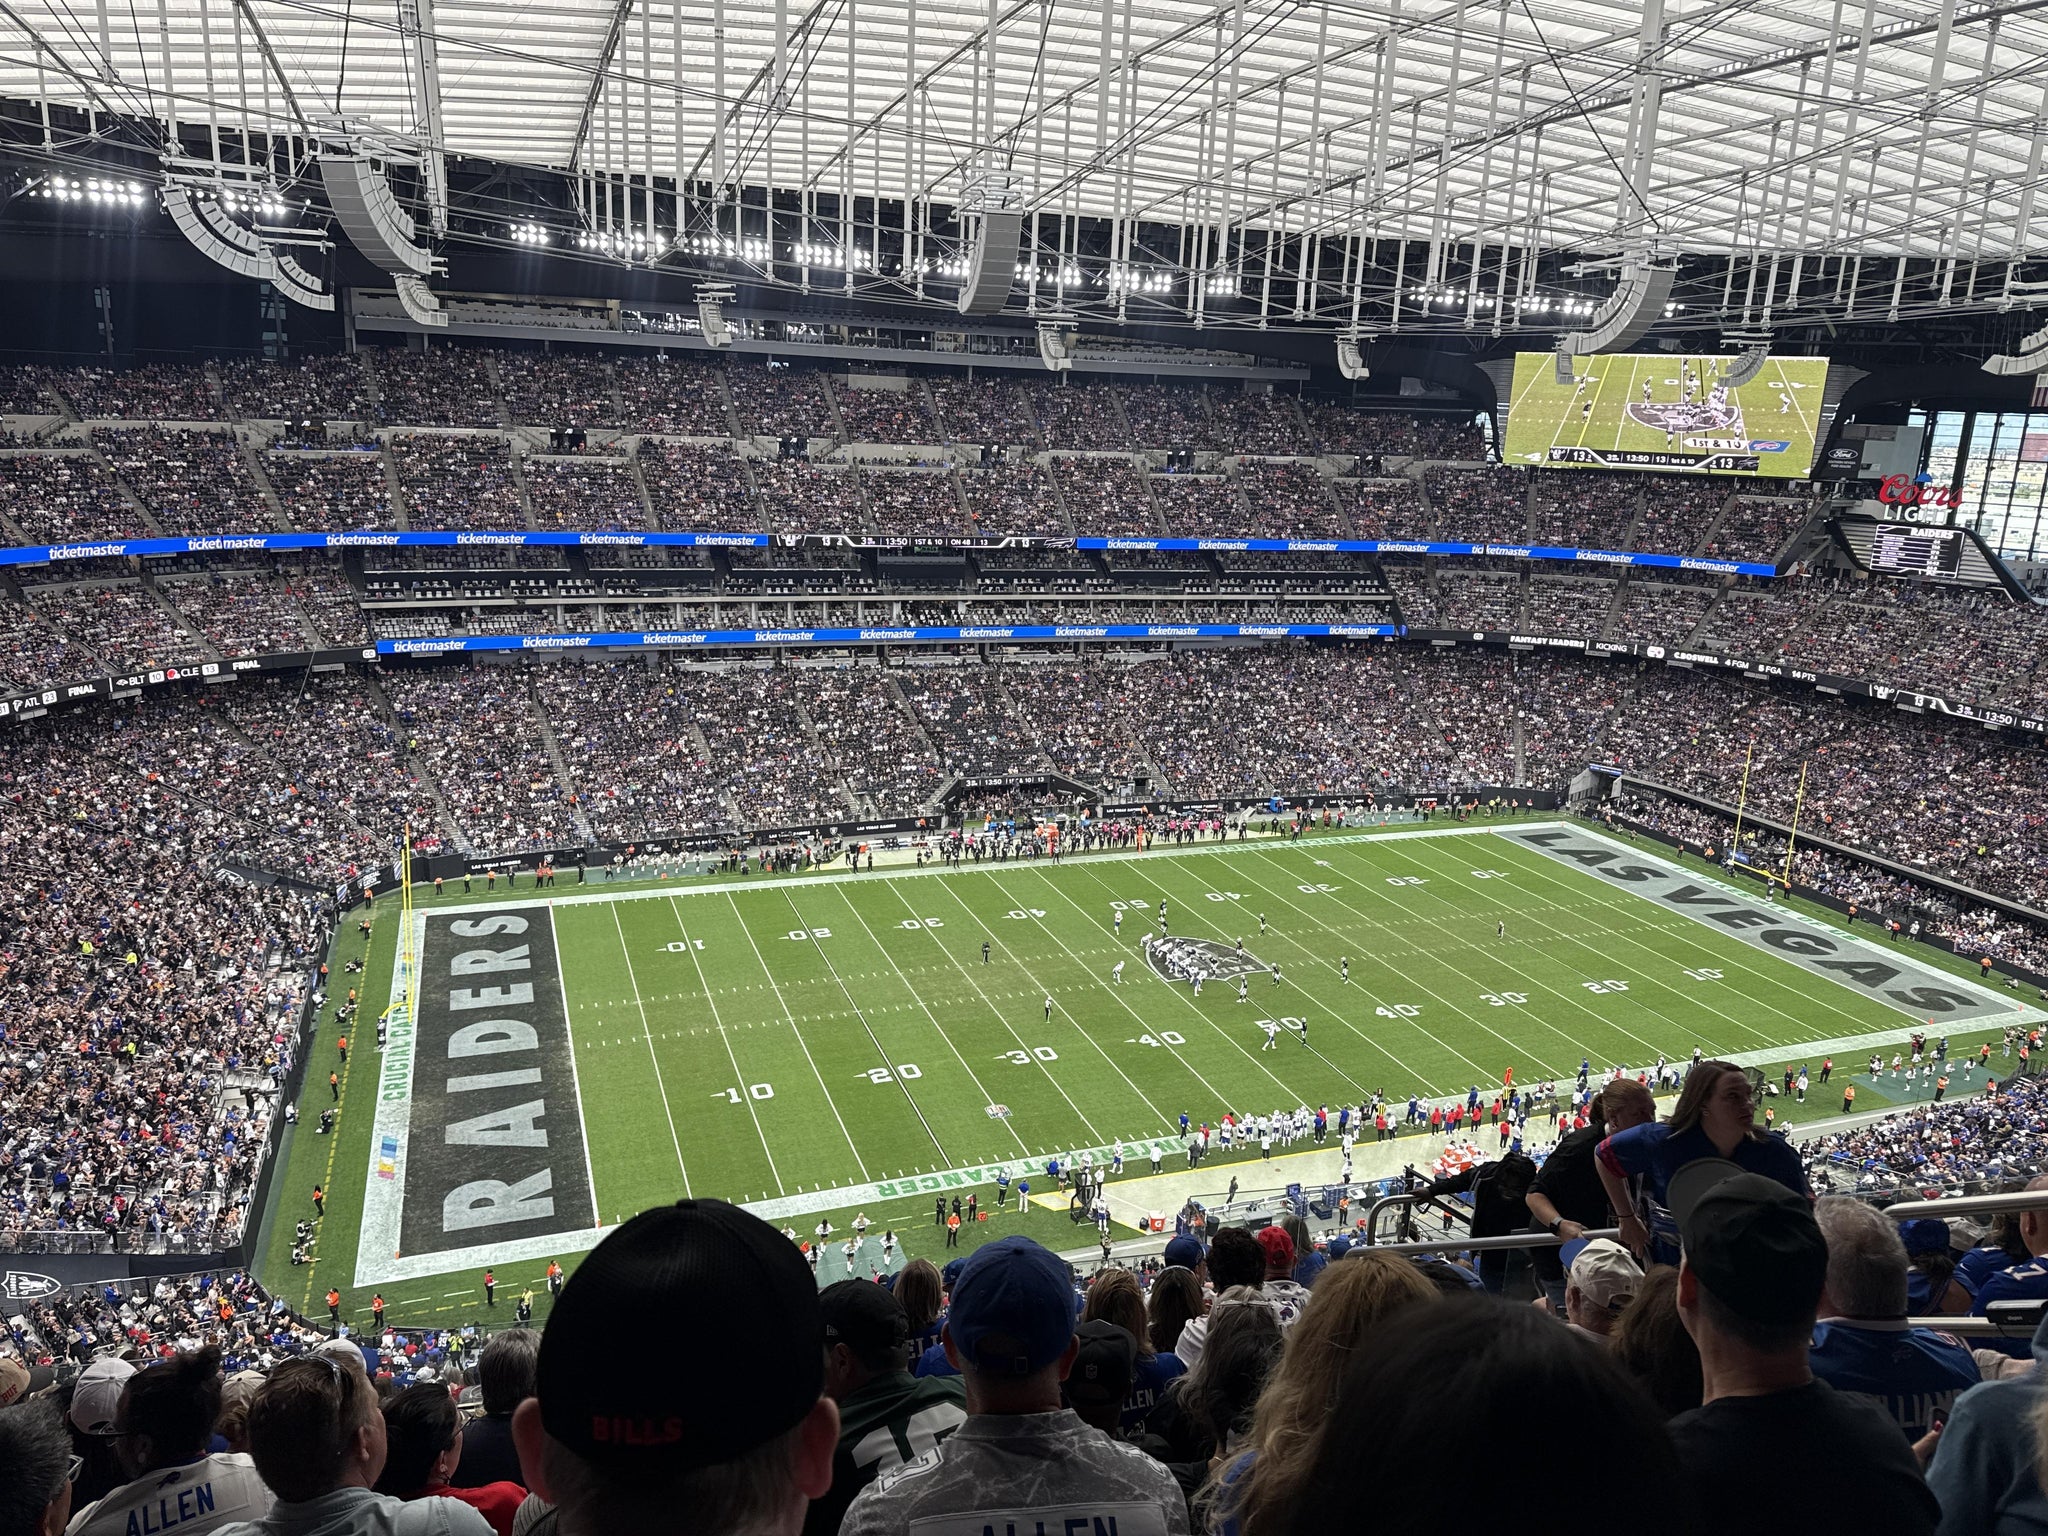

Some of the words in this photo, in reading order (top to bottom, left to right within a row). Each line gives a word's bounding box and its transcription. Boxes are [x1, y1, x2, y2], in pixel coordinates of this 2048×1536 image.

[1573, 451, 1586, 462] 13
[1626, 454, 1650, 462] 13:50
[1720, 458, 1733, 468] 13
[1878, 474, 1963, 508] Coors
[457, 533, 526, 544] ticketmaster
[1910, 528, 1954, 539] RAIDERS
[188, 536, 266, 550] ticketmaster
[326, 534, 400, 546] ticketmaster
[580, 534, 645, 546] ticketmaster
[695, 534, 756, 546] ticketmaster
[1107, 539, 1158, 550] ticketmaster
[1198, 540, 1249, 550] ticketmaster
[1288, 541, 1338, 551] ticketmaster
[49, 544, 126, 559] ticketmaster
[1377, 543, 1429, 554] ticketmaster
[1472, 545, 1531, 557] ticketmaster
[1576, 550, 1634, 565] ticketmaster
[1680, 558, 1739, 573] ticketmaster
[755, 632, 814, 641] ticketmaster
[860, 630, 917, 640] ticketmaster
[959, 628, 1014, 638] ticketmaster
[1055, 627, 1107, 637] ticketmaster
[1148, 626, 1199, 636] ticketmaster
[1238, 626, 1289, 636] ticketmaster
[1329, 626, 1380, 636] ticketmaster
[394, 640, 466, 652] ticketmaster
[522, 636, 591, 648] ticketmaster
[643, 634, 706, 646] ticketmaster
[1510, 636, 1547, 644] FANTASY
[1549, 638, 1585, 648] LEADERS
[1596, 642, 1627, 652] KICKING
[129, 676, 145, 685] BLT
[180, 667, 199, 677] CLE
[206, 664, 216, 673] 13
[232, 660, 260, 671] FINAL
[1802, 672, 1816, 682] PTS
[24, 697, 40, 708] ATL
[45, 693, 55, 702] 23
[68, 684, 96, 698] FINAL
[1985, 711, 2013, 725] 13:50
[2021, 719, 2036, 730] 1ST
[1519, 833, 1669, 884] LAS
[1662, 884, 1979, 1012] VEGAS
[788, 928, 832, 940] 20
[667, 940, 706, 952] 10
[1682, 968, 1724, 980] 10
[1582, 980, 1629, 994] 20
[1480, 992, 1528, 1006] 30
[1375, 1004, 1420, 1019] 40
[1138, 1031, 1186, 1047] 40
[1005, 1046, 1059, 1065] 30
[383, 1041, 411, 1100] CRUCIAL
[443, 915, 554, 1232] RAIDERS
[867, 1064, 923, 1084] 20
[726, 1083, 775, 1104] 10
[878, 1166, 1004, 1196] CANCER
[0, 1384, 18, 1402] BUF
[592, 1416, 684, 1446] BILLS
[126, 1482, 214, 1536] ALLEN
